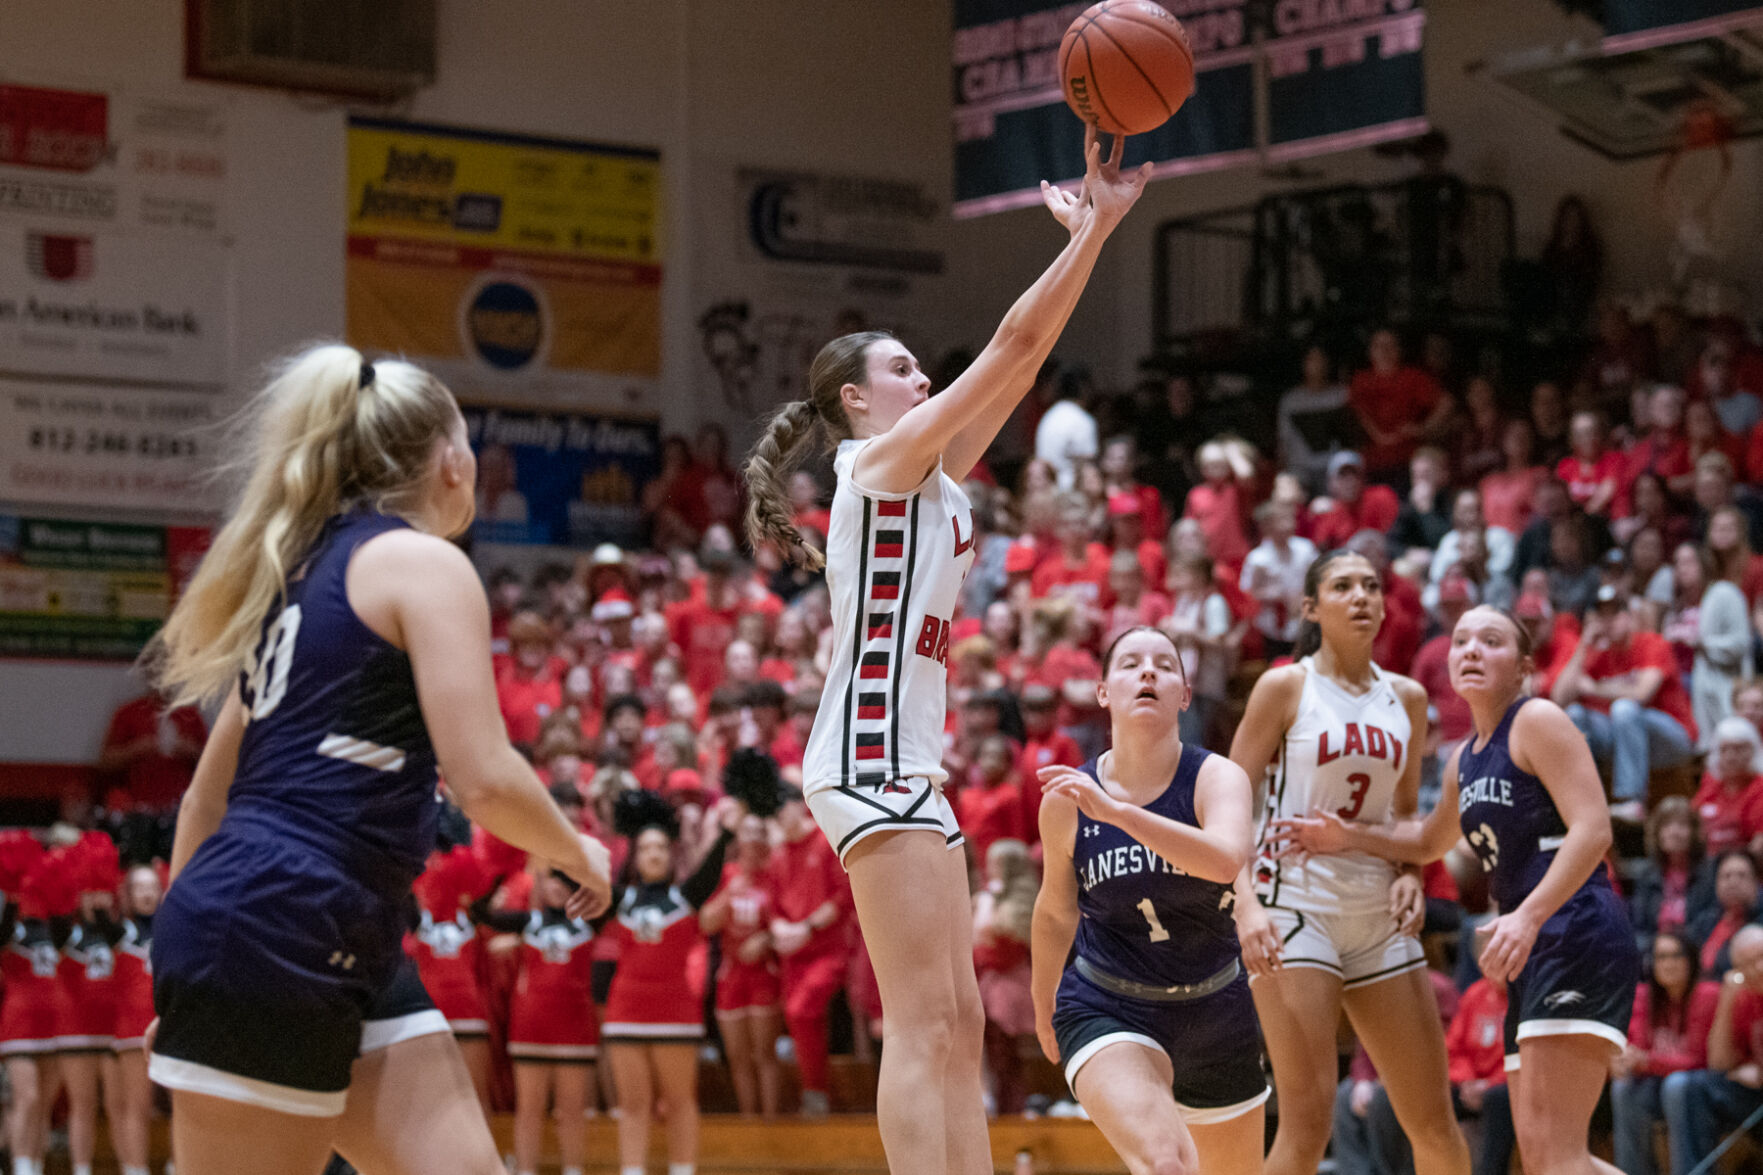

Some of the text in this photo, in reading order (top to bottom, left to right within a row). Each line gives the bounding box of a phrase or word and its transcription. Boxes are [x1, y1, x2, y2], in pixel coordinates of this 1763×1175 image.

[1317, 722, 1402, 771] LADY
[1336, 772, 1371, 819] 3
[1136, 897, 1170, 943] 1
